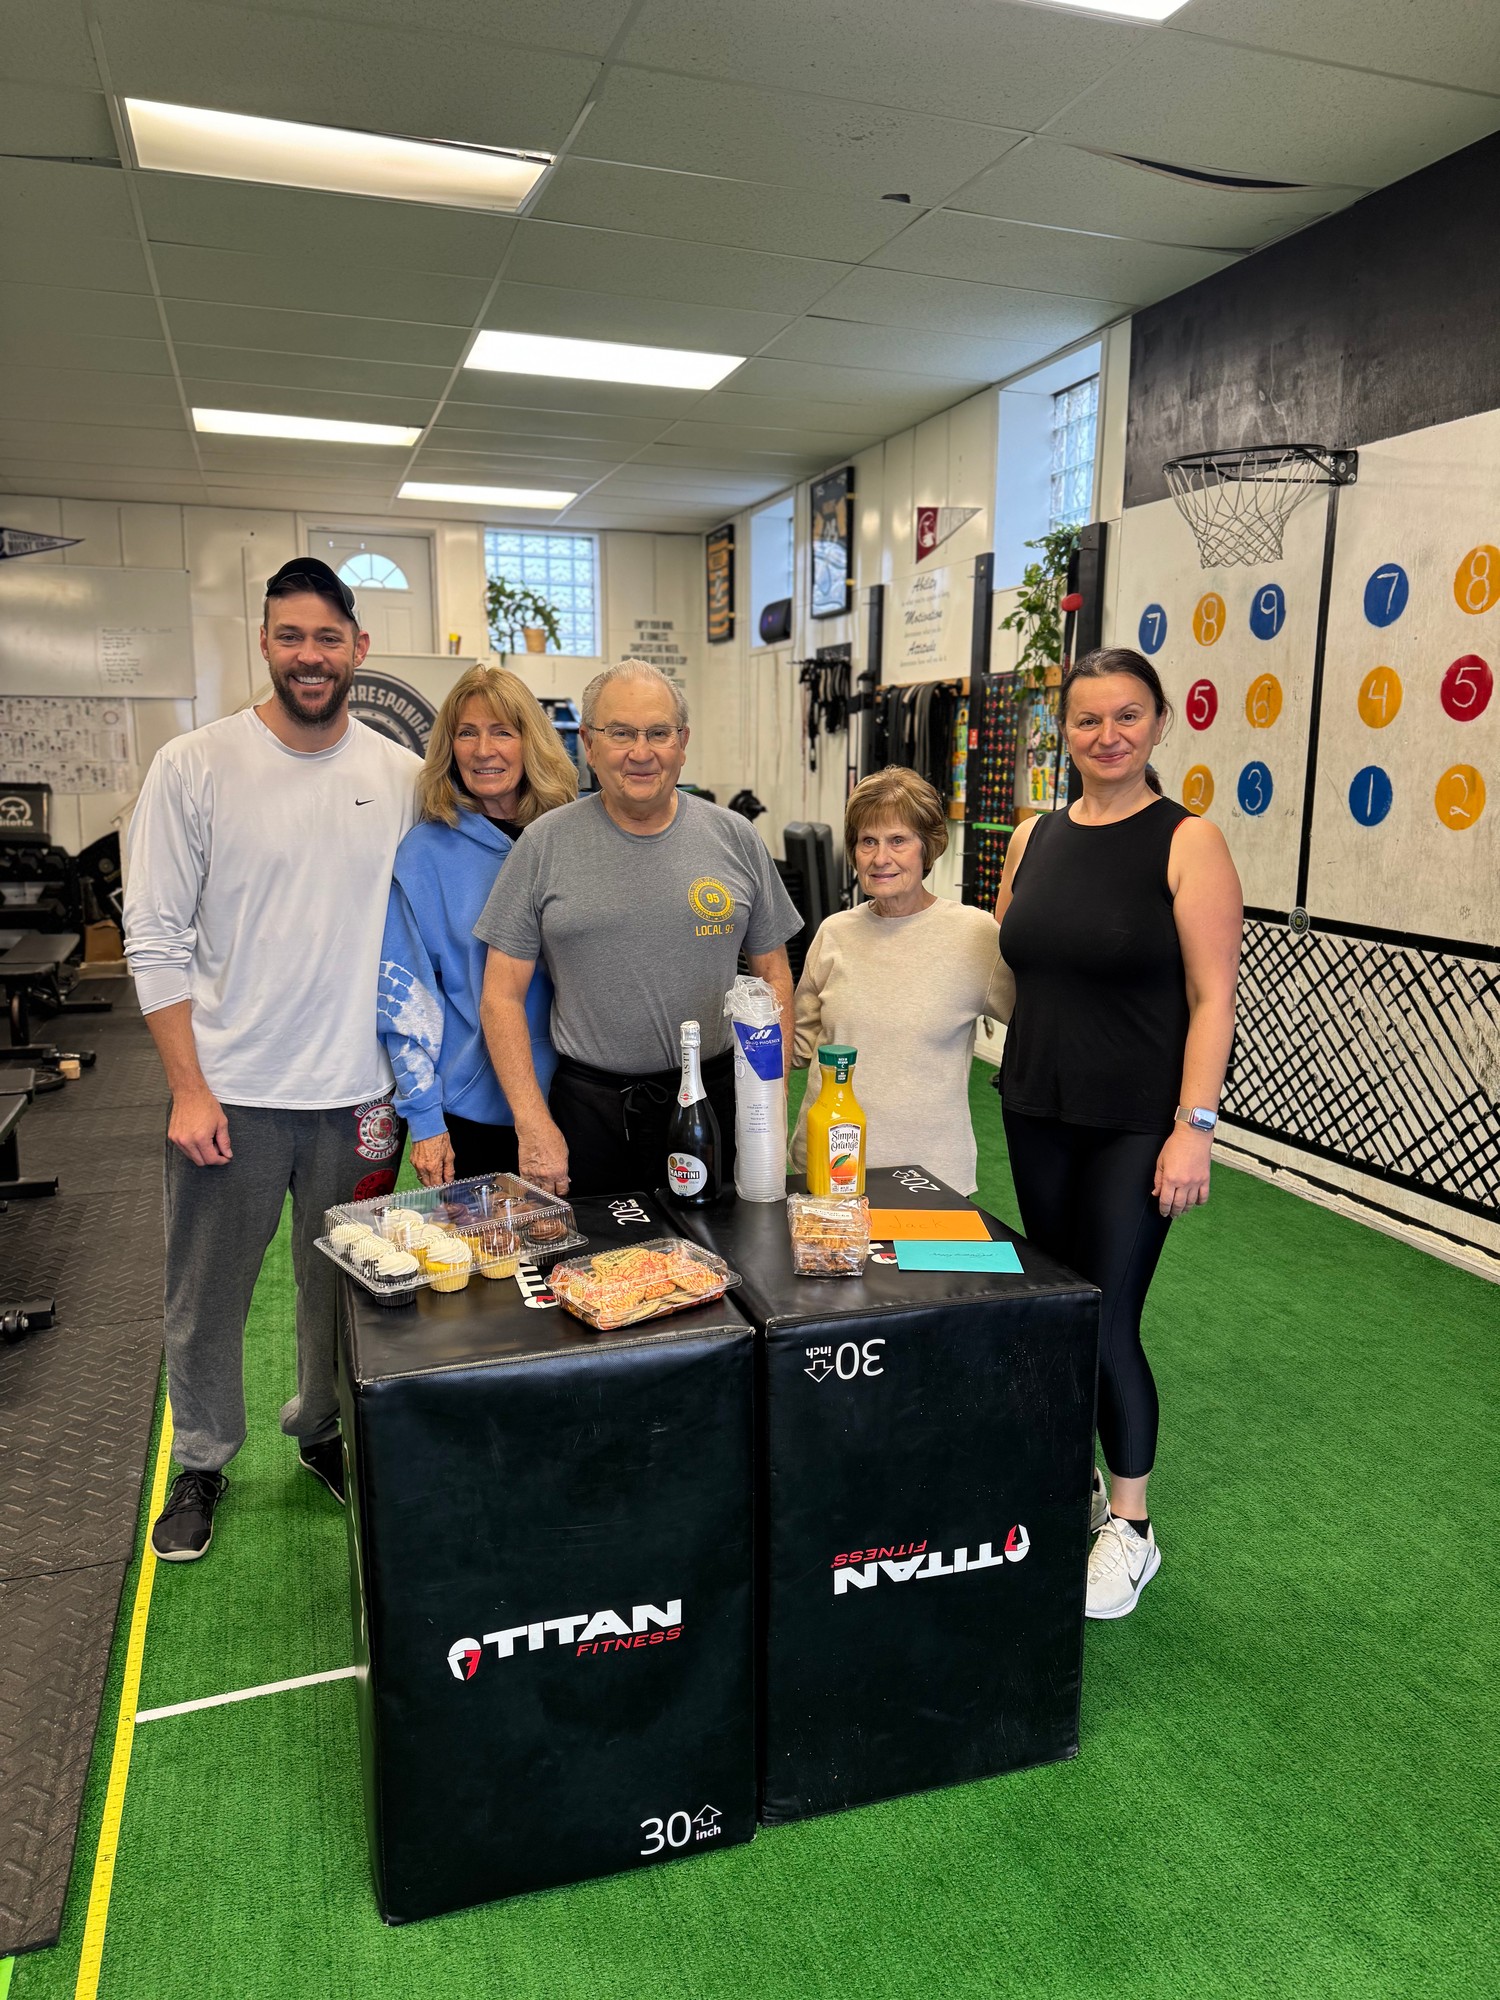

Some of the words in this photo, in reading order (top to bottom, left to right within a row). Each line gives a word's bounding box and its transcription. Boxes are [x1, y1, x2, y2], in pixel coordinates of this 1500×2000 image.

[1377, 572, 1399, 614] 7
[1466, 551, 1490, 610] 8
[1146, 612, 1161, 646] 7
[1201, 597, 1218, 645] 8
[1260, 590, 1277, 631] 9
[1192, 686, 1211, 723] 5
[1254, 680, 1272, 723] 6
[1368, 679, 1388, 718] 4
[1452, 667, 1481, 708] 5
[1189, 773, 1205, 807] 2
[1245, 769, 1264, 811] 3
[1367, 773, 1374, 818] 1
[1449, 773, 1471, 818] 2
[705, 893, 720, 904] 95
[695, 924, 723, 937] LOCAL
[725, 924, 735, 934] 95
[831, 1130, 859, 1142] Simply
[831, 1141, 859, 1152] Orange
[900, 1178, 941, 1193] 20
[612, 1208, 651, 1225] 20
[805, 1345, 832, 1359] inch
[835, 1338, 886, 1380] 30
[833, 1539, 928, 1568] FITNESS
[834, 1542, 1004, 1595] TITAN
[483, 1599, 682, 1659] TITAN
[576, 1627, 682, 1657] FITNESS
[640, 1811, 691, 1855] 30
[695, 1825, 721, 1841] inch
